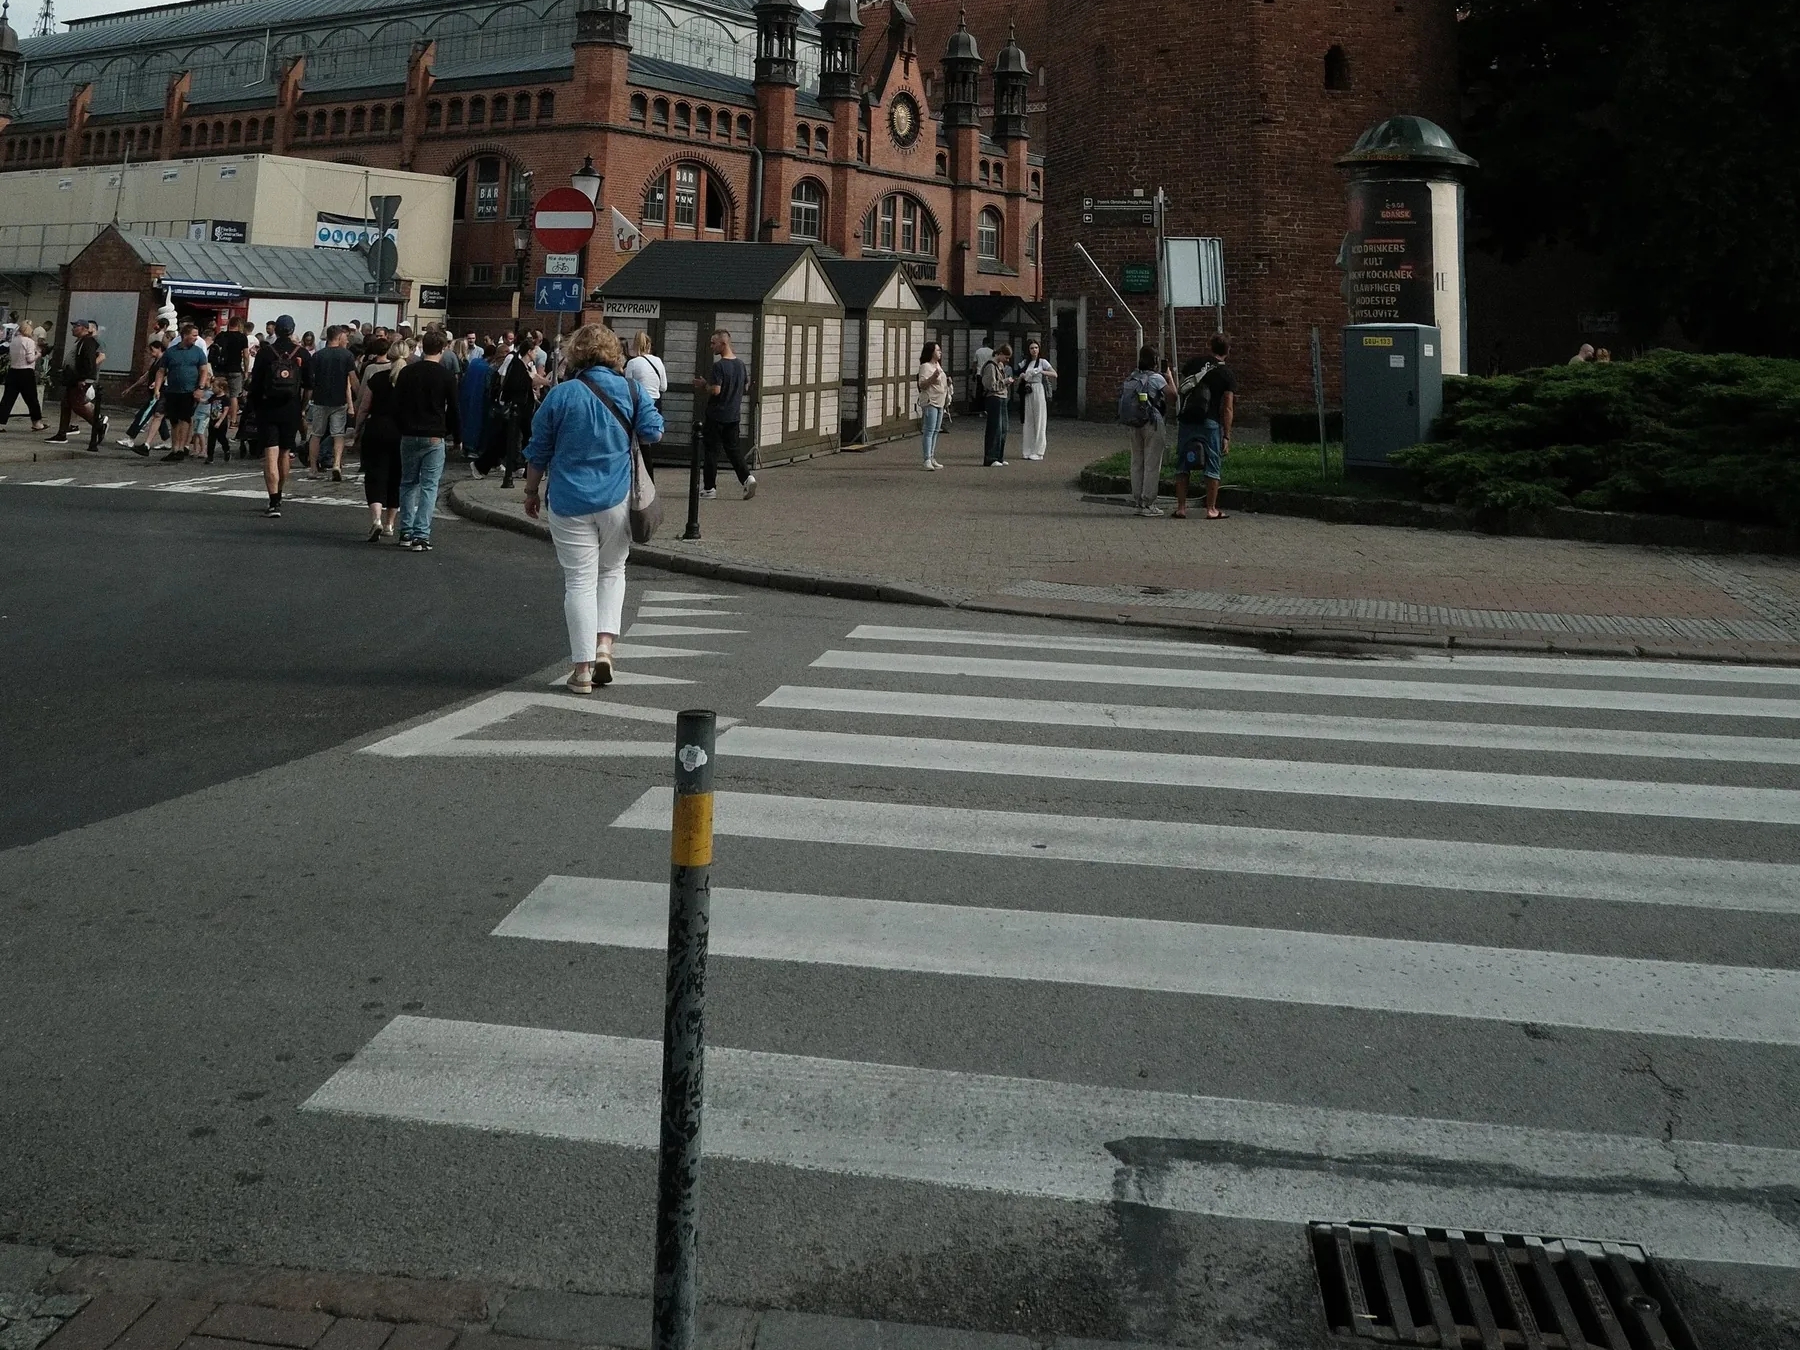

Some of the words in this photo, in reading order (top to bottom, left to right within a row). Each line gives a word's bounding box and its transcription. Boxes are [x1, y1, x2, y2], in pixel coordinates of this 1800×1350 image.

[676, 170, 694, 183] BAR
[480, 188, 499, 199] BAR
[1381, 209, 1411, 219] GDAŃSK
[1363, 244, 1406, 254] DRINKERS
[1363, 257, 1384, 266] KULT
[1366, 270, 1413, 280] KOCHANEK
[1353, 283, 1401, 293] CLAWFINGER
[1355, 296, 1397, 306] MODESTEP
[606, 302, 658, 314] PRZYPRAWY
